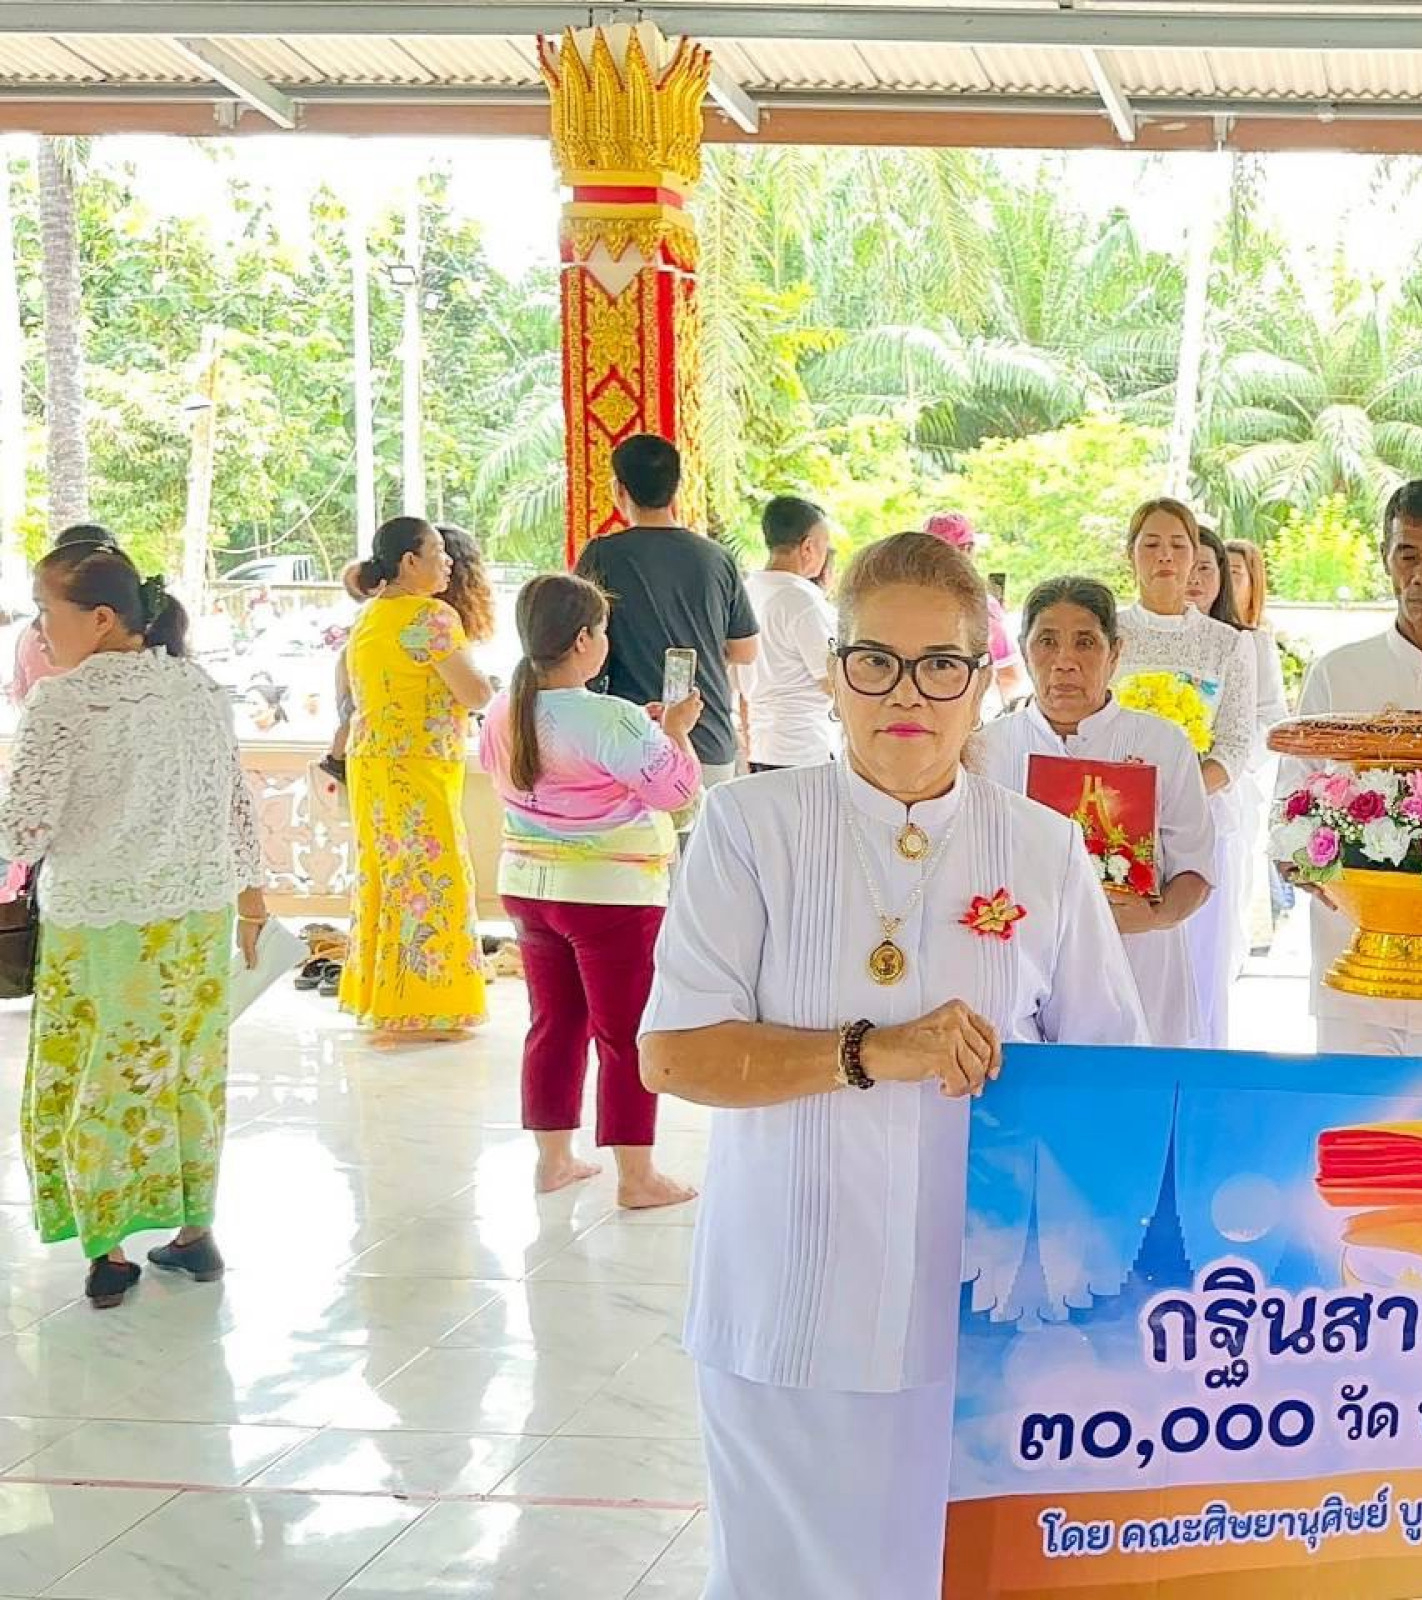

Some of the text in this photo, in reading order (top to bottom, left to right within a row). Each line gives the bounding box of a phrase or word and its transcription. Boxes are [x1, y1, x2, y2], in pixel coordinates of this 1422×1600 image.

[1020, 1399, 1314, 1469] ๓๐,๐๐๐
[1337, 1384, 1399, 1441] วัด
[1042, 1512, 1111, 1553] โดย
[1122, 1489, 1389, 1548] คณะศิษยานุศิษย์
